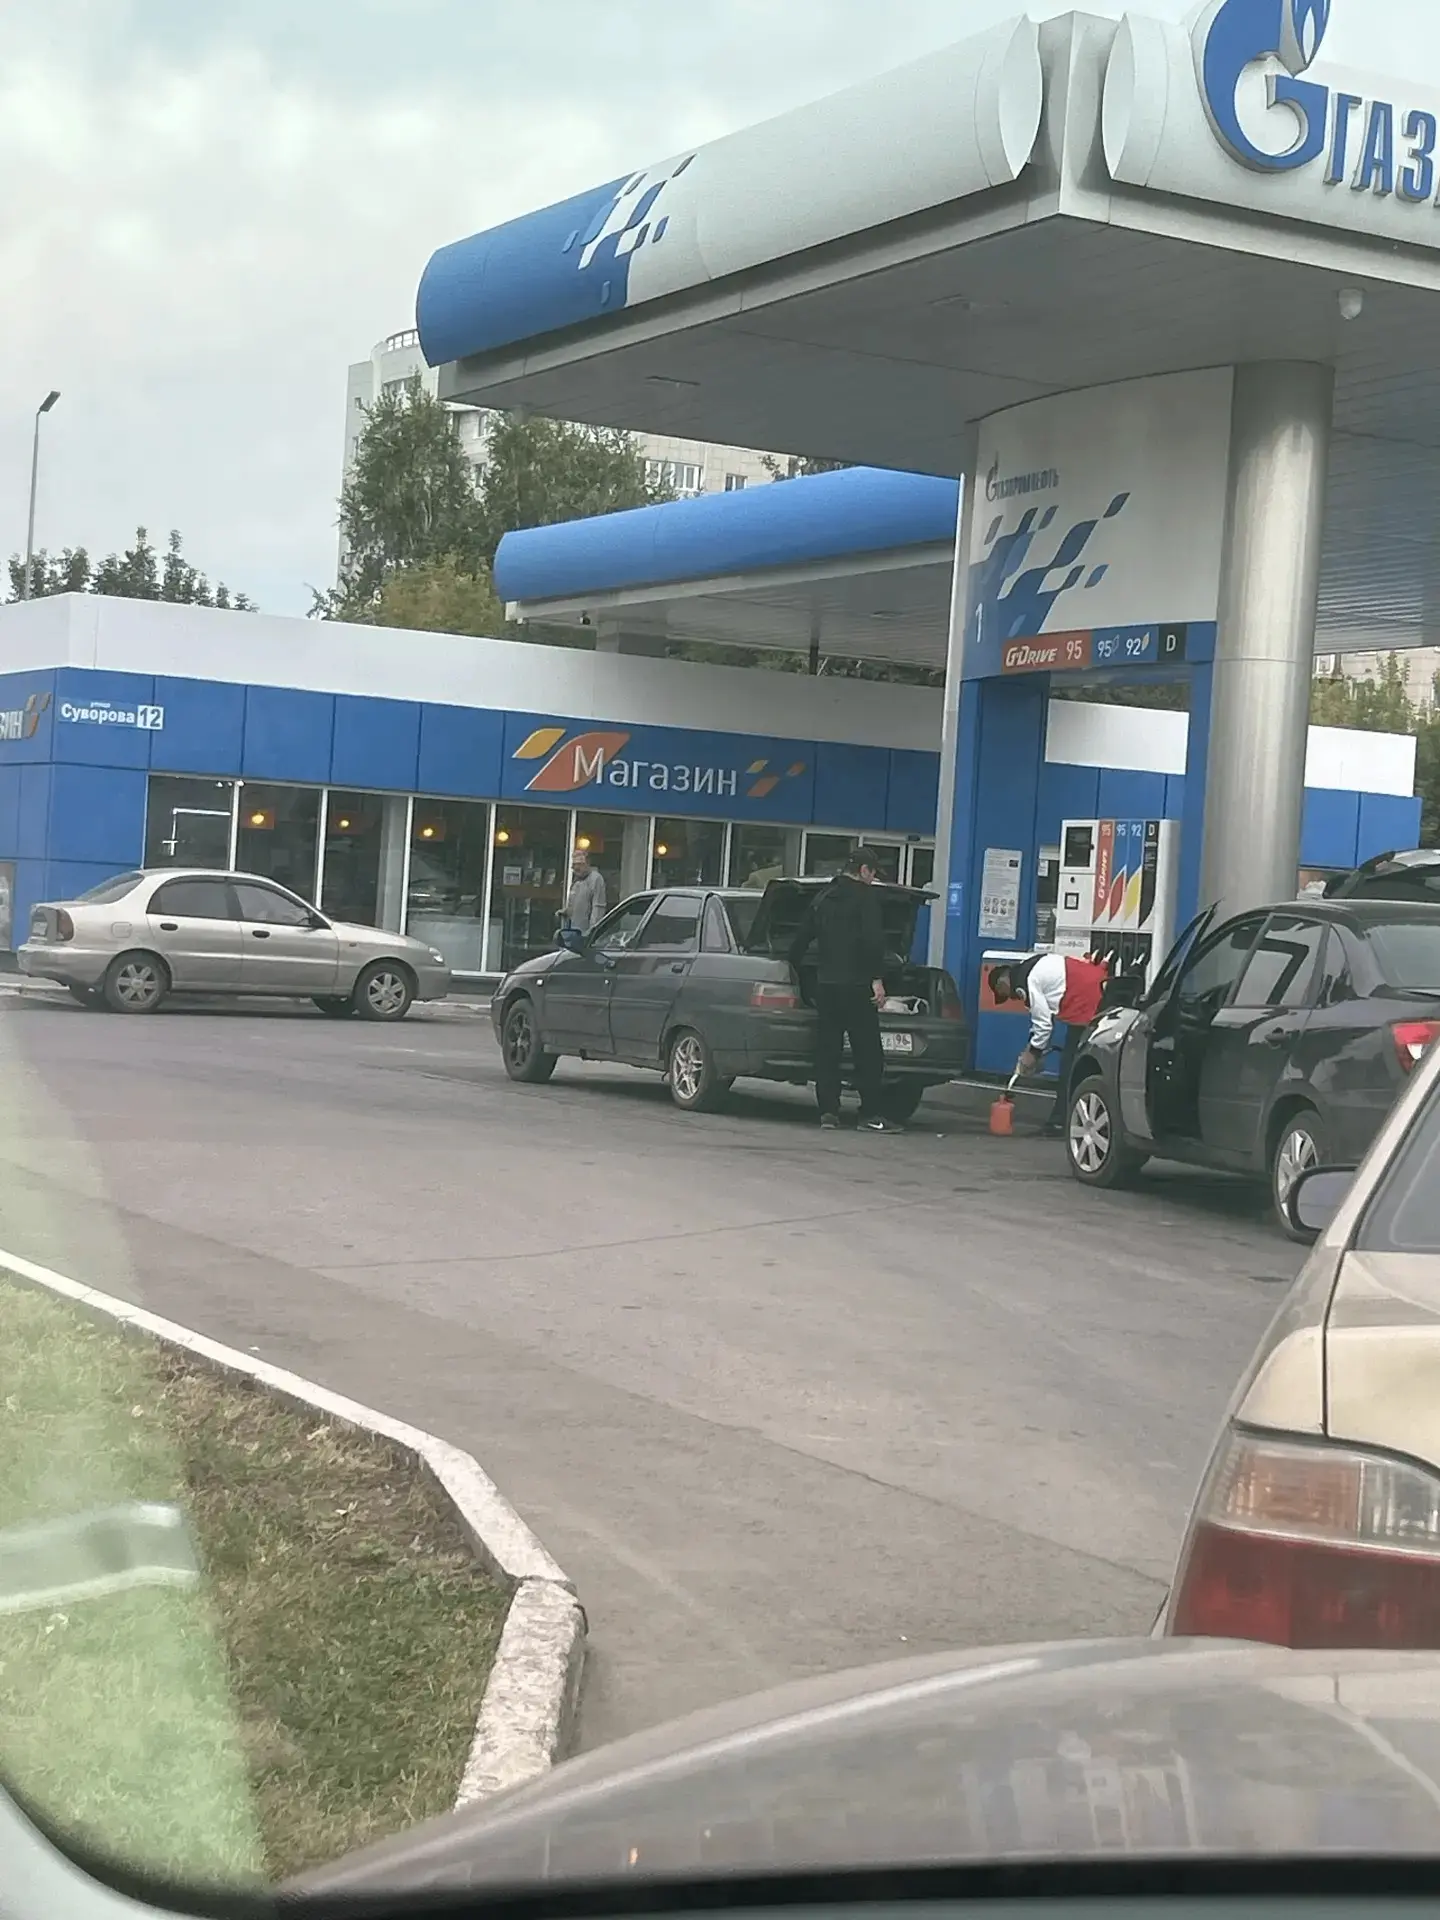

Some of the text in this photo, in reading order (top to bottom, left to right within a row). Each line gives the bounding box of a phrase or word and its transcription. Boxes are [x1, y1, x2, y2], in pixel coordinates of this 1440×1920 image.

[1323, 92, 1440, 208] ГАЗ
[975, 602, 984, 643] 1
[1066, 640, 1083, 661] 95
[1098, 640, 1112, 658] 95
[1125, 638, 1141, 656] 92
[1166, 634, 1176, 652] D
[61, 703, 162, 729] Суворова 12
[573, 745, 737, 796] Магазин
[1101, 823, 1155, 837] 95 95 92 D
